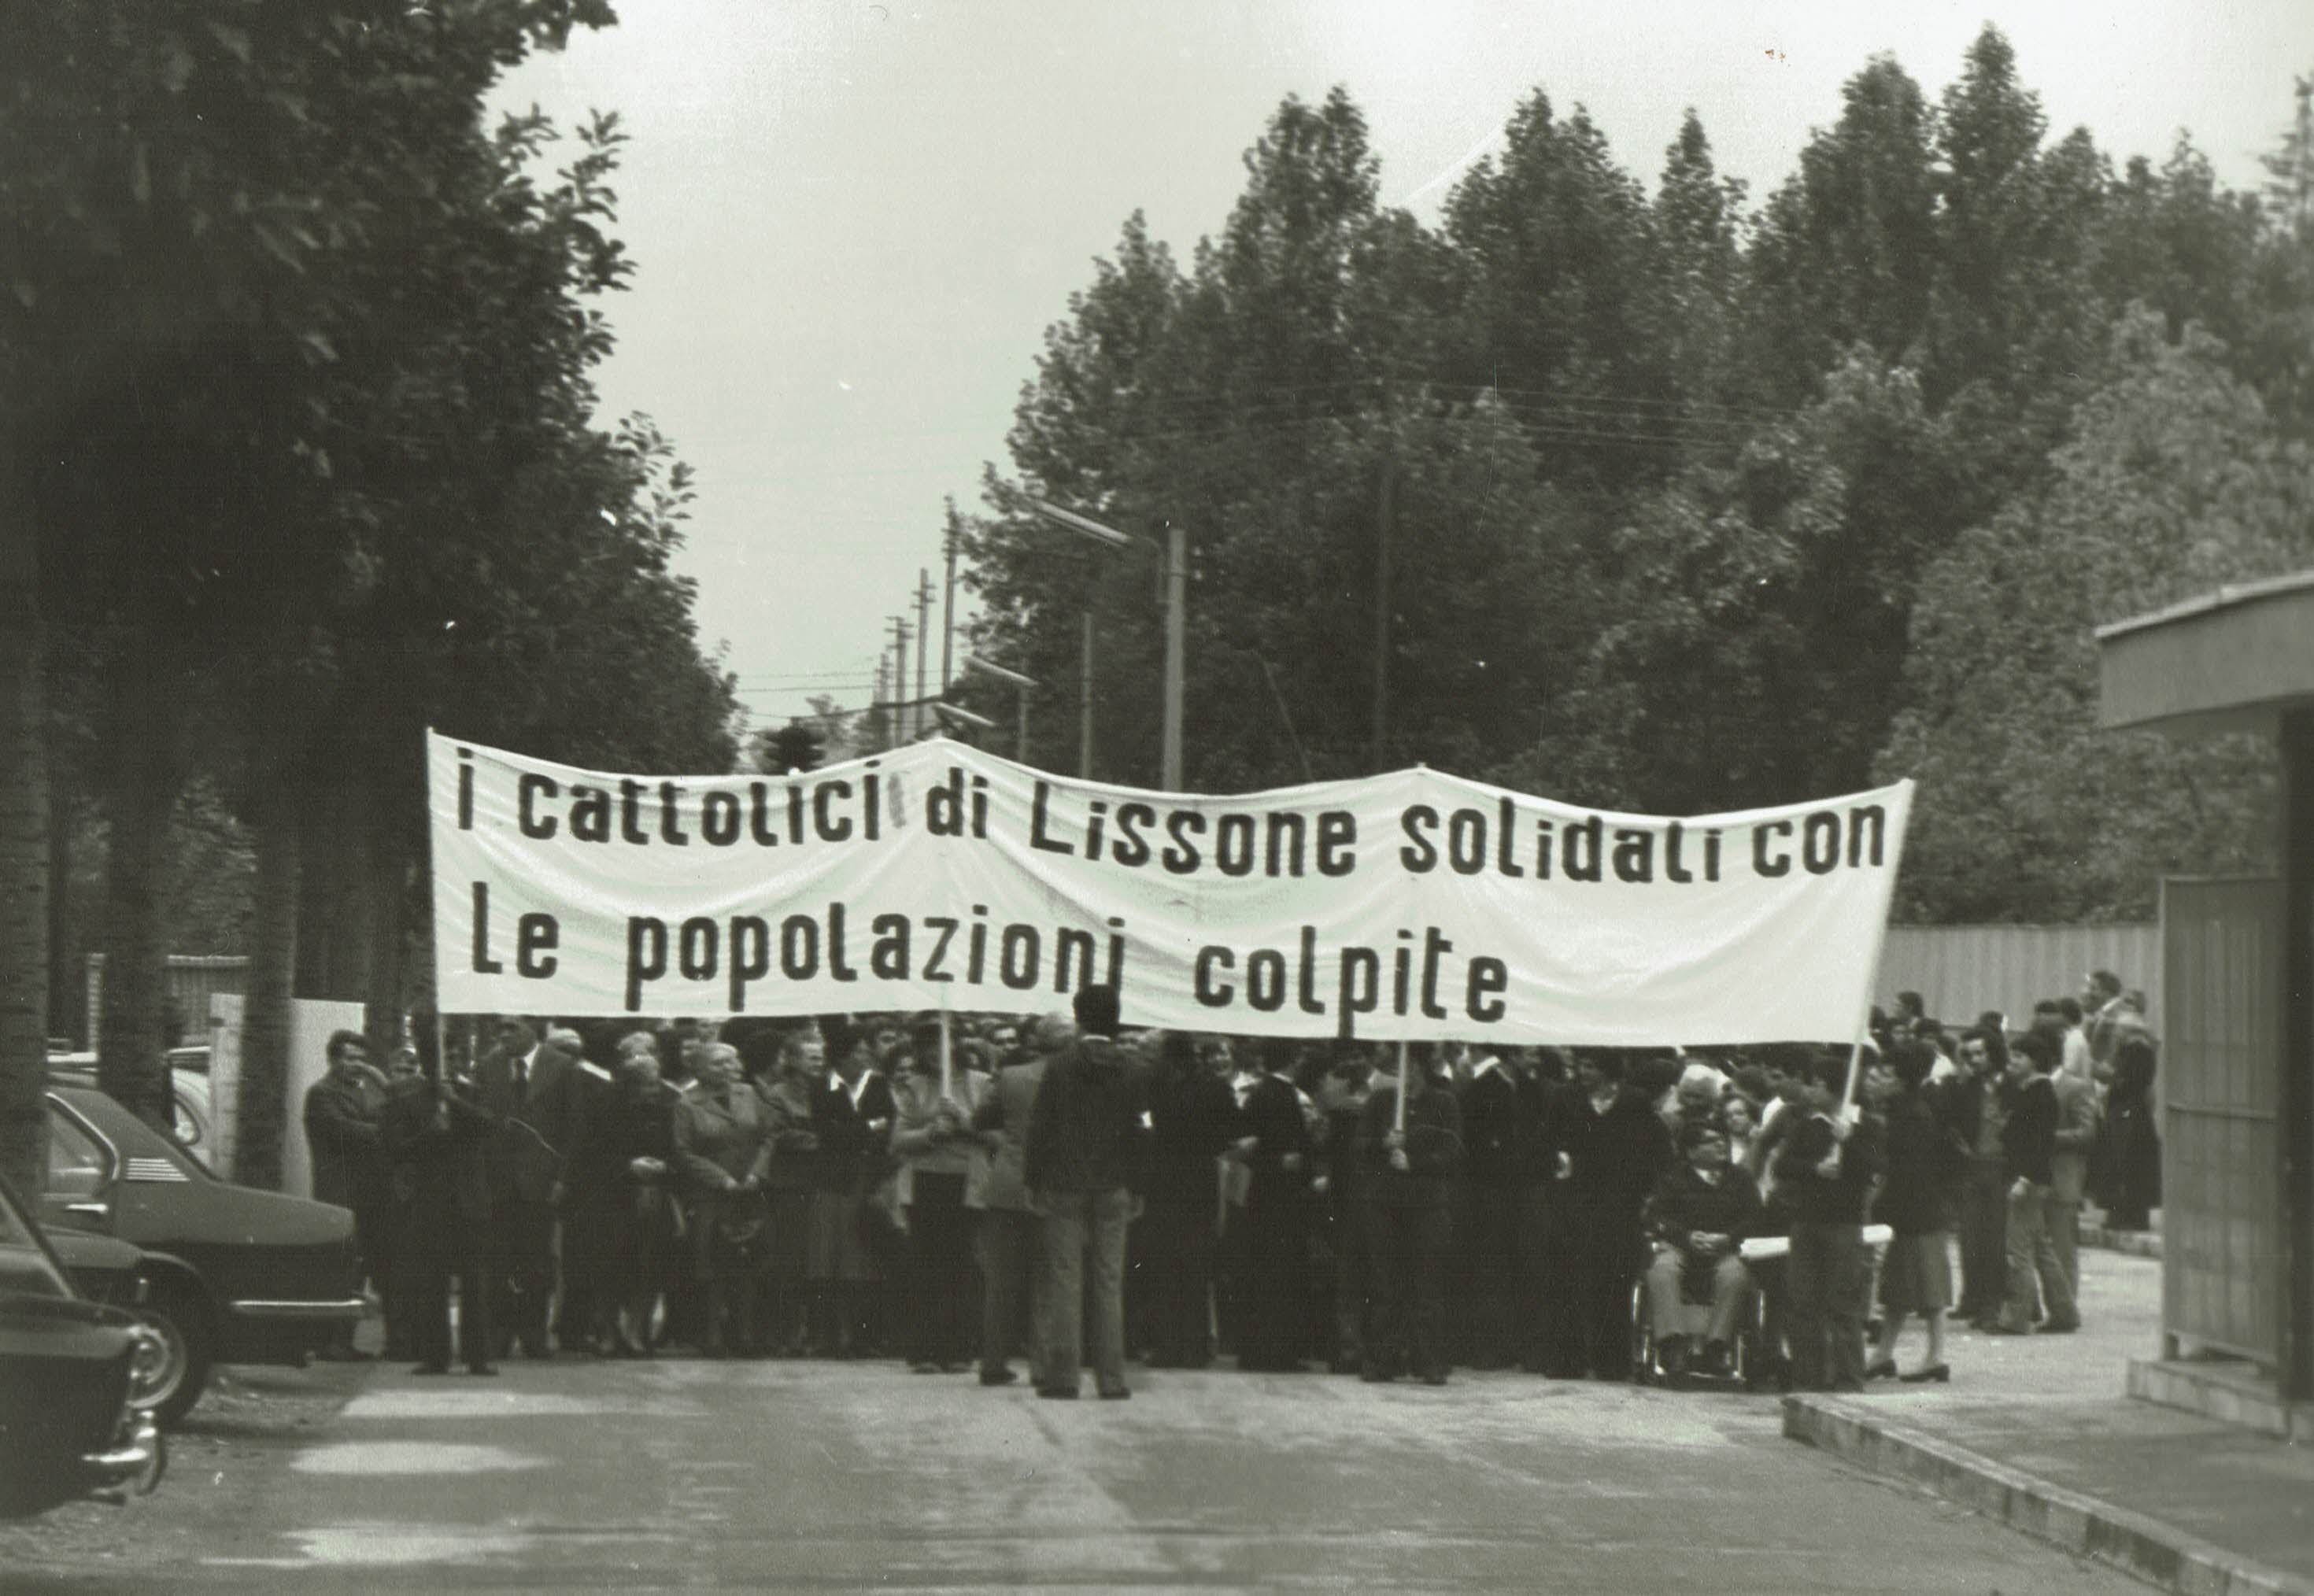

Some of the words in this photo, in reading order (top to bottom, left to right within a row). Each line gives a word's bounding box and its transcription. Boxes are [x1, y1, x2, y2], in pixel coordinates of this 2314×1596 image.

[925, 766, 988, 839] di
[1029, 781, 1357, 877] Lissone
[1399, 796, 1722, 883] solidali
[1751, 803, 1886, 879] con
[624, 901, 1126, 1013] popolazioni
[1193, 924, 1509, 1040] colpite
